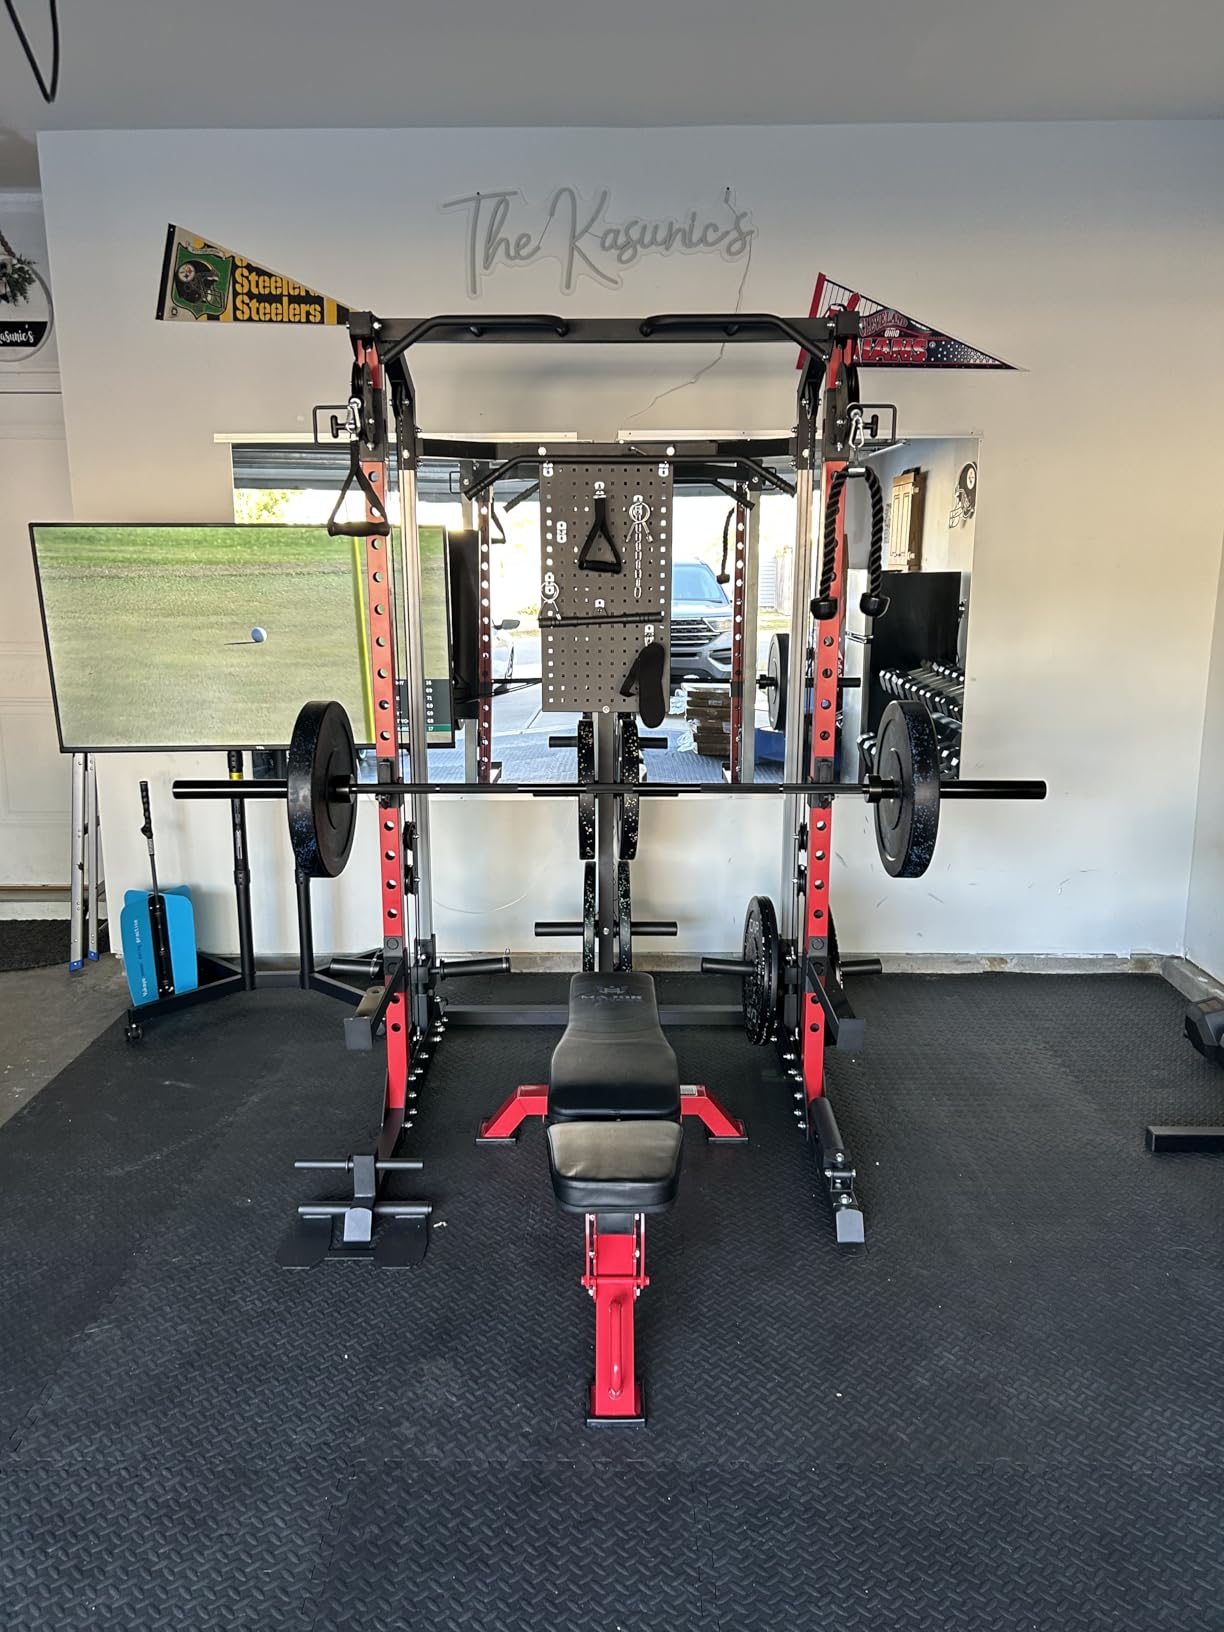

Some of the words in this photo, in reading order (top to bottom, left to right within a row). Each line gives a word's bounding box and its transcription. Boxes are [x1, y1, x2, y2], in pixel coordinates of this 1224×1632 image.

[442, 190, 542, 294] The
[550, 187, 756, 290] Kasunic's
[235, 294, 321, 322] Steelers
[0, 323, 34, 344] asunic's
